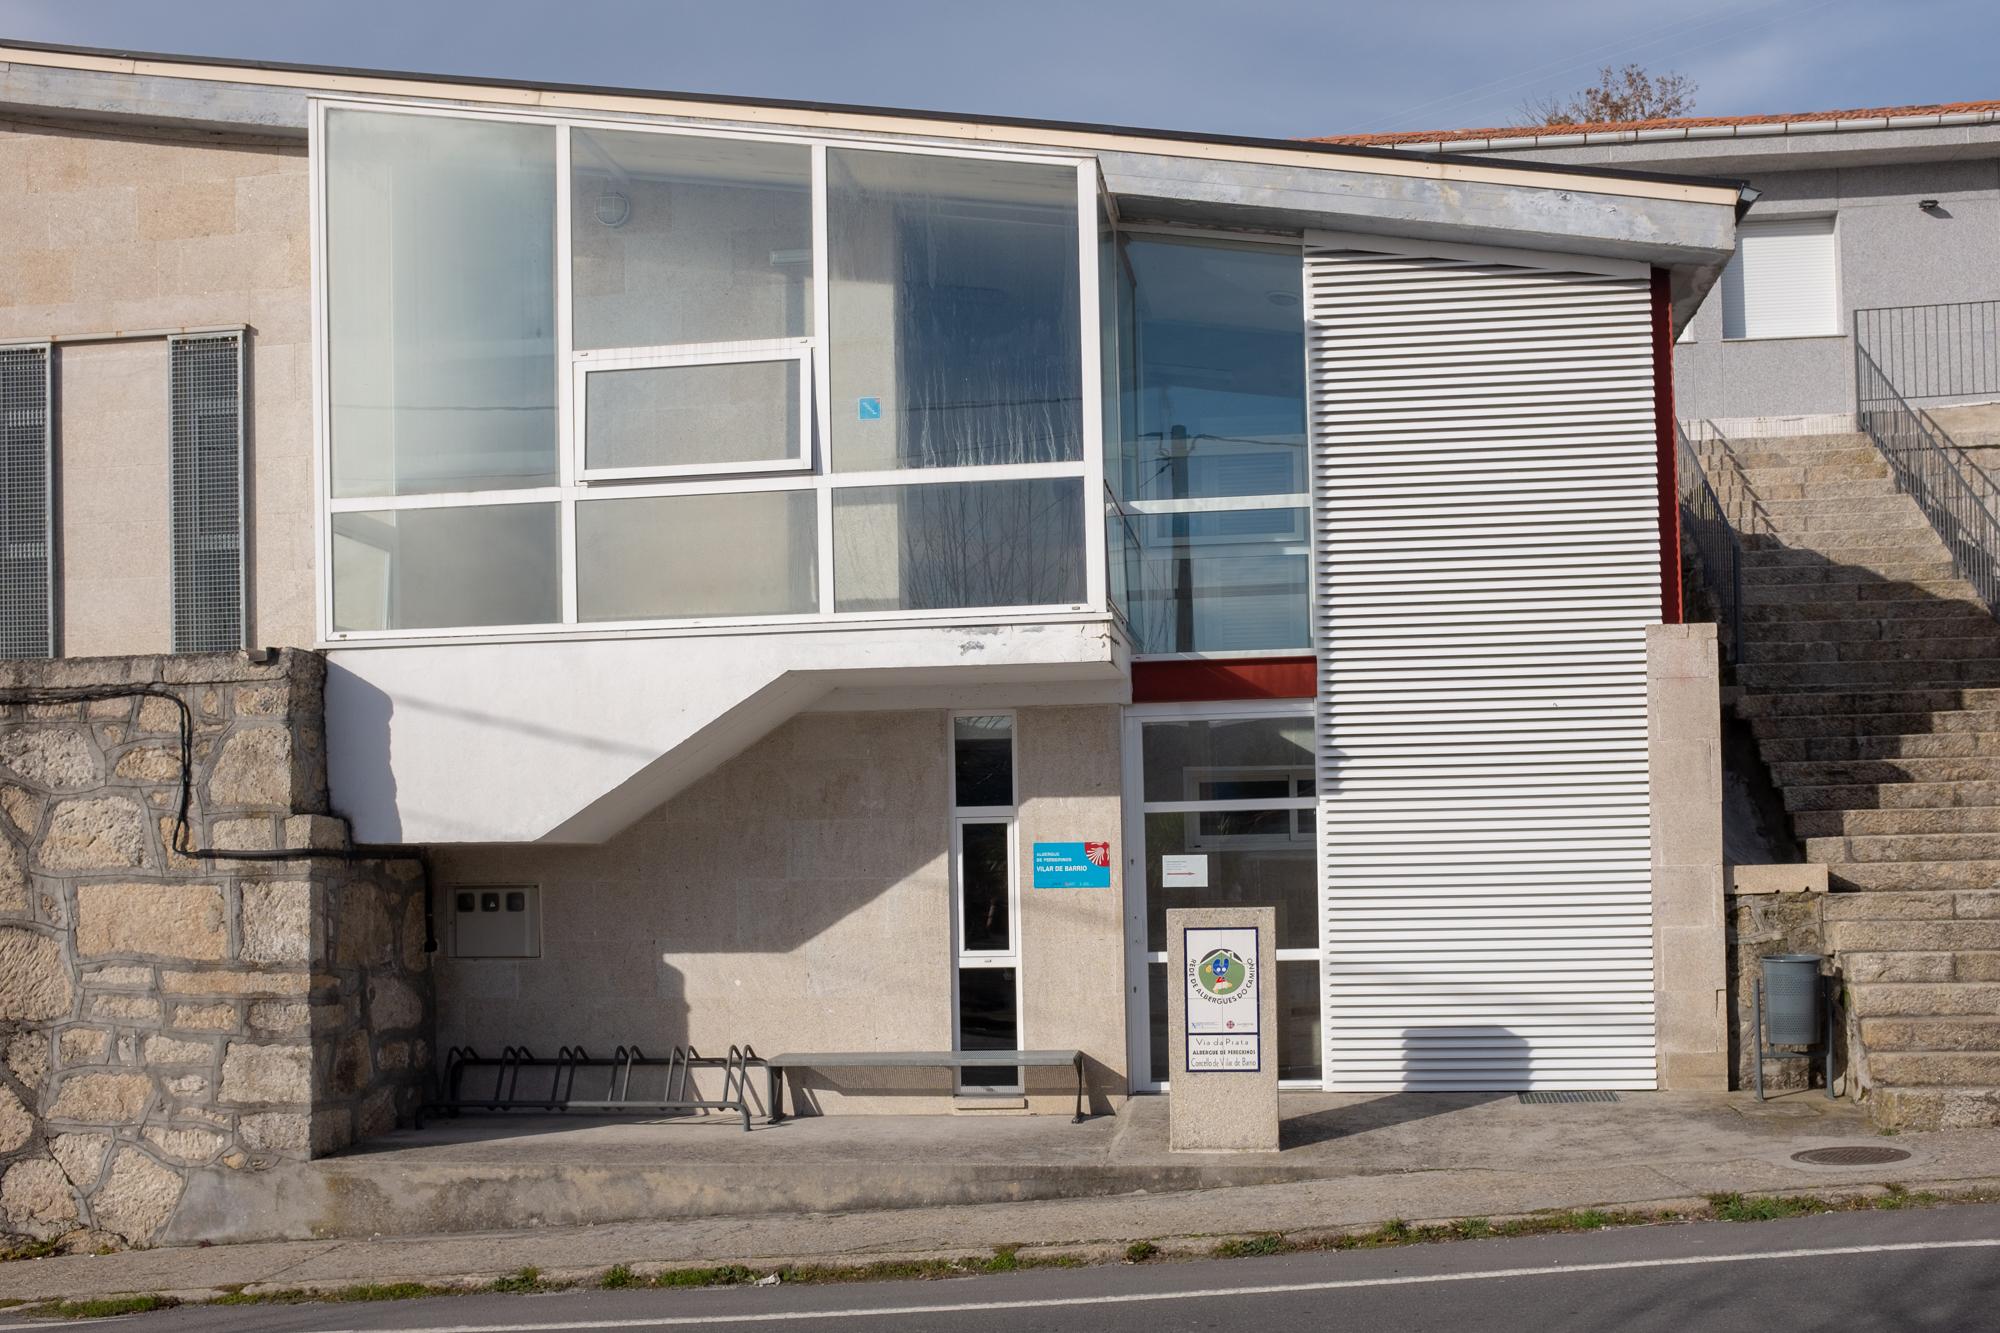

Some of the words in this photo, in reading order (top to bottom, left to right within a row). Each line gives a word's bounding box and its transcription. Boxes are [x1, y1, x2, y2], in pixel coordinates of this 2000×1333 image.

[1189, 958, 1197, 977] REDE
[1190, 978, 1199, 988] DE
[1196, 988, 1237, 1005] ALBERGUES
[1236, 988, 1248, 999] DO
[1213, 1038, 1224, 1046] da
[1225, 1038, 1249, 1046] Prata
[1212, 1057, 1219, 1067] de
[1233, 1057, 1241, 1067] de
